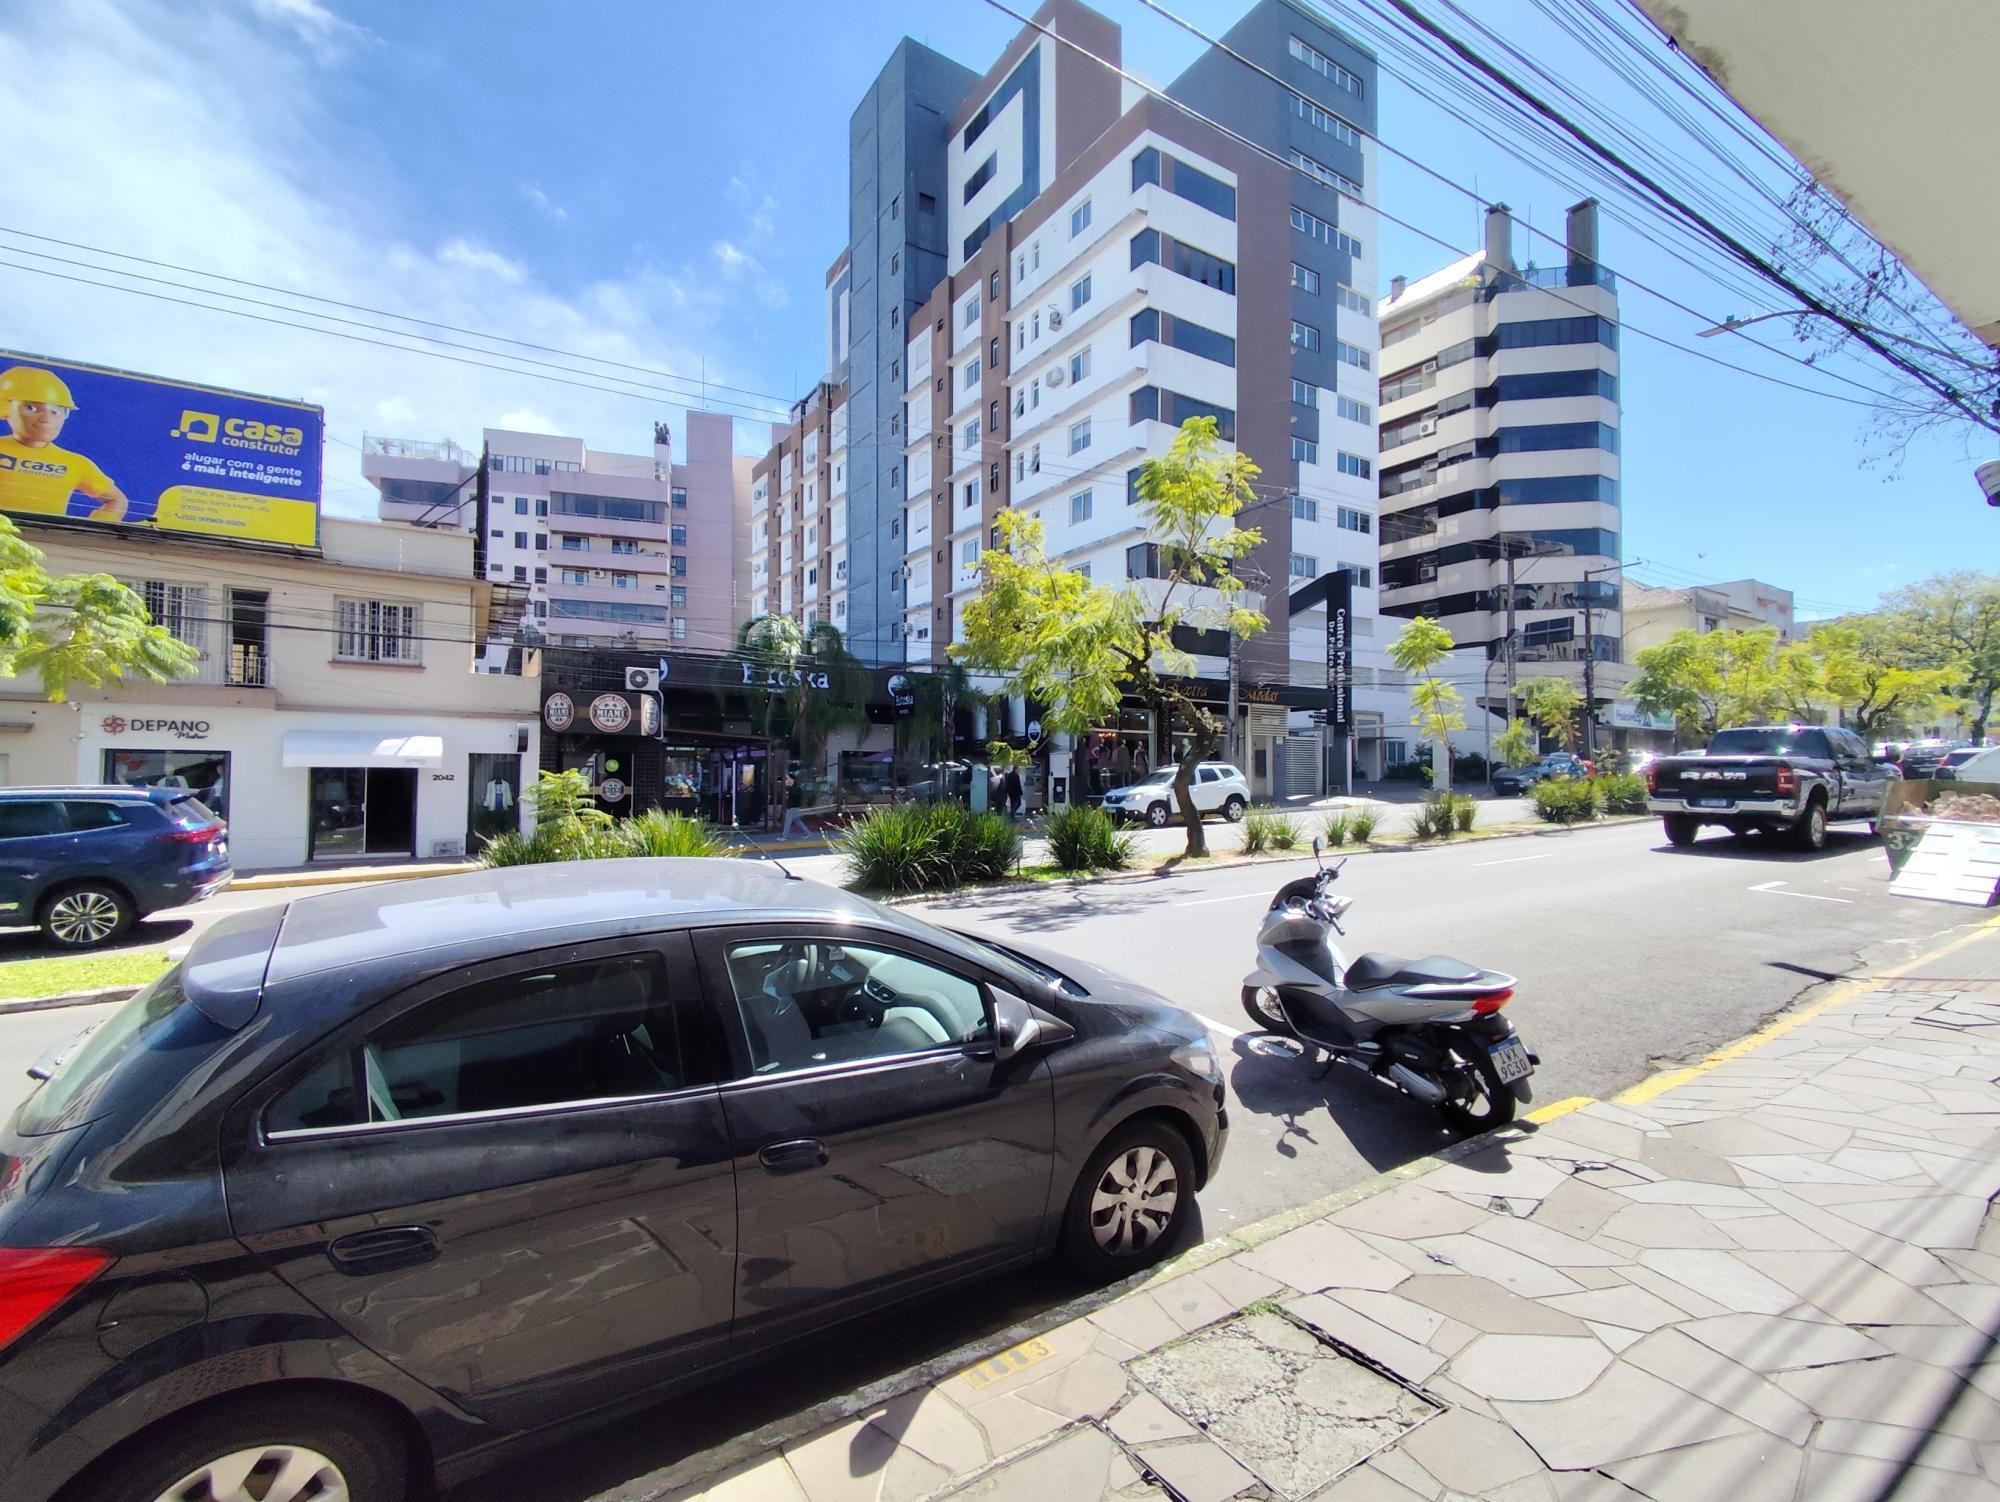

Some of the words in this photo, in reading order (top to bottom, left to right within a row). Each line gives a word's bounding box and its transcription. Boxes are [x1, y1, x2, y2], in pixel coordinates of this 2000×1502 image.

[225, 418, 303, 446] casa
[222, 437, 300, 456] construtor
[21, 459, 67, 474] casa
[181, 461, 191, 471] é
[193, 463, 226, 476] mais
[229, 467, 302, 487] inteligente
[184, 452, 224, 465] alugar
[226, 459, 254, 469] com
[266, 465, 302, 477] gente
[1336, 608, 1346, 648] Centro
[549, 707, 569, 717] MIAMI
[596, 708, 624, 718] MIAMI
[130, 719, 210, 733] DEPANO
[1680, 771, 1747, 781] RAM
[1500, 1058, 1528, 1080] 9C30
